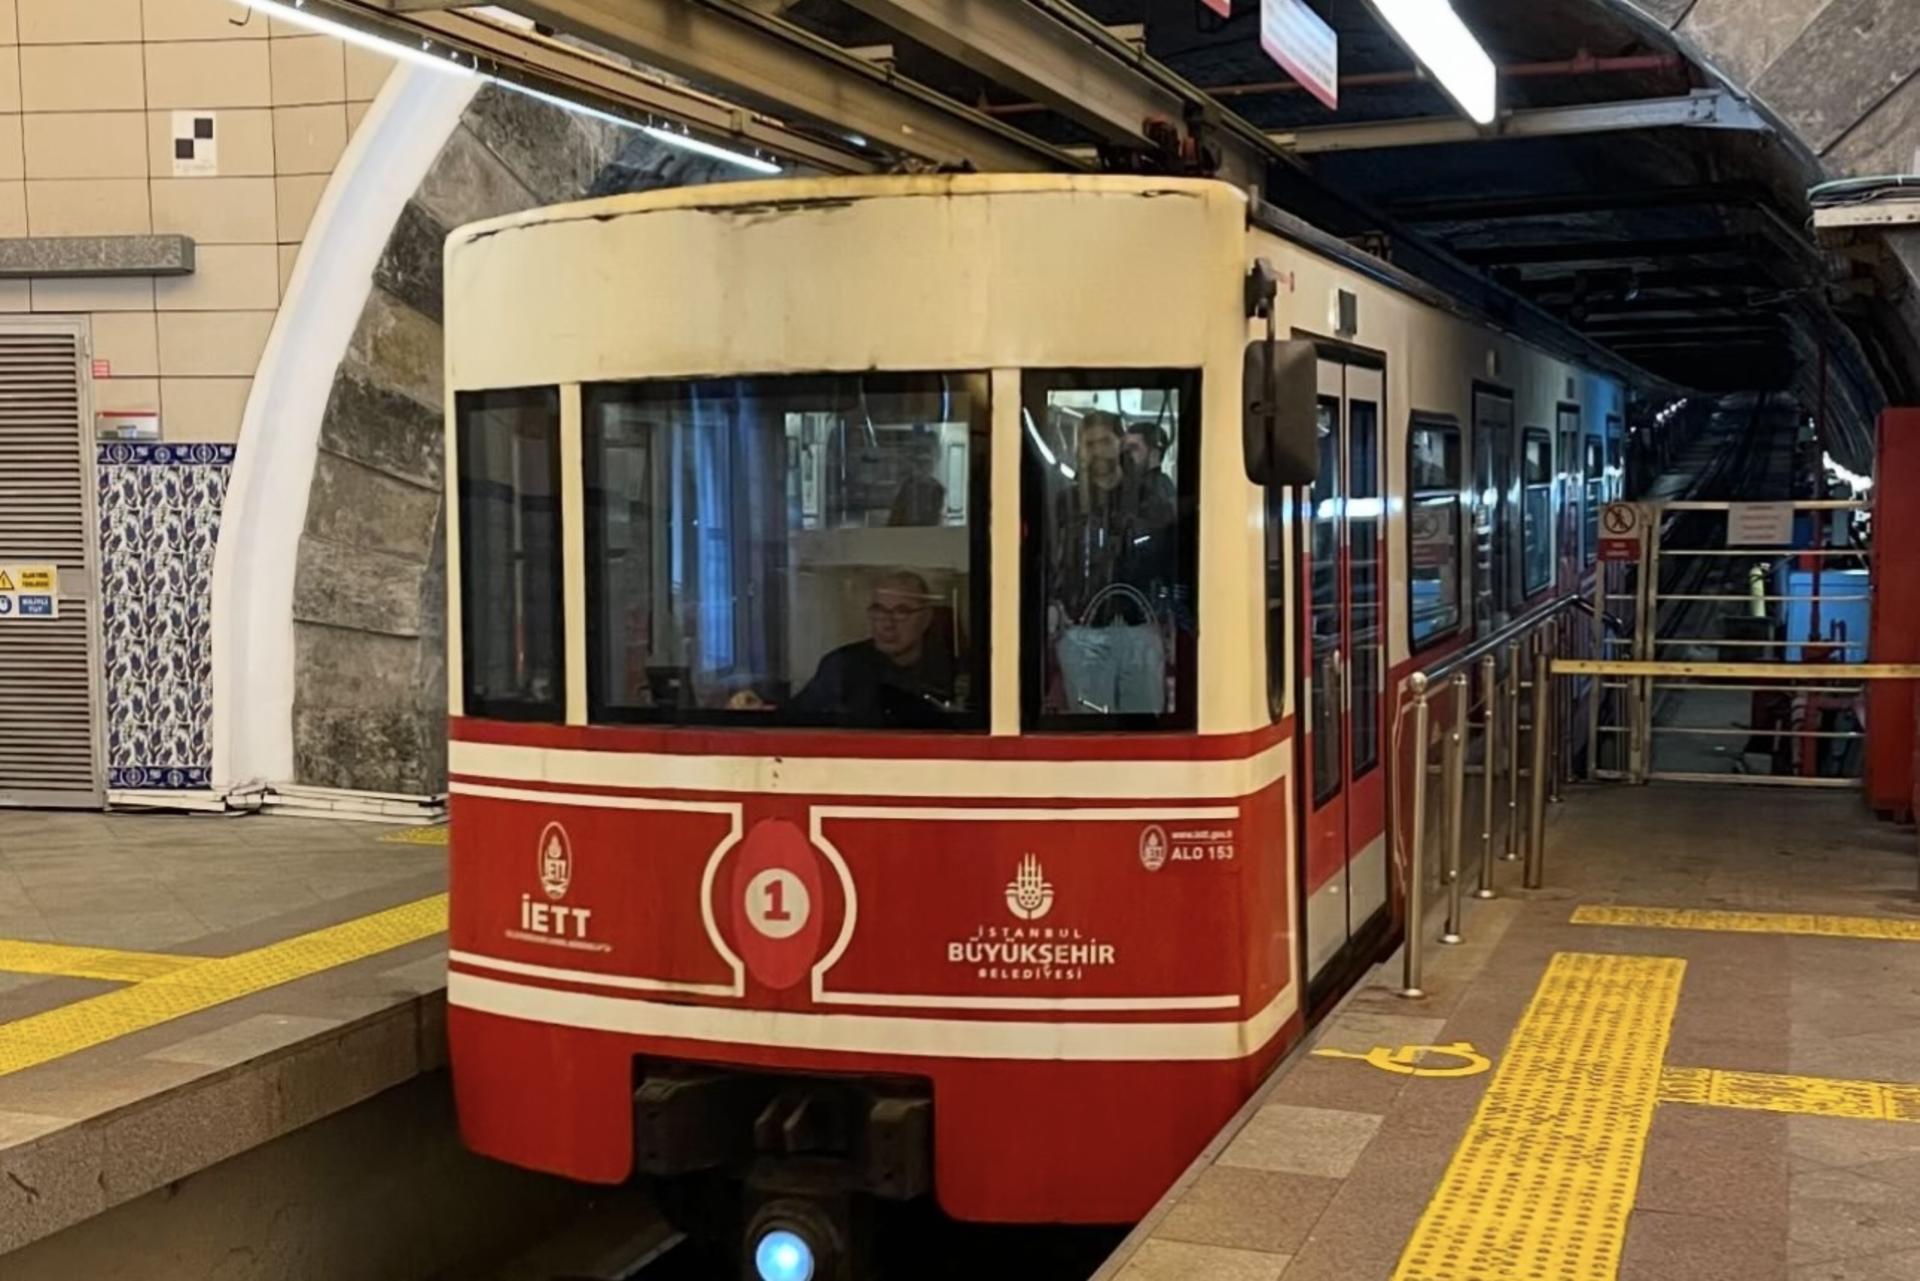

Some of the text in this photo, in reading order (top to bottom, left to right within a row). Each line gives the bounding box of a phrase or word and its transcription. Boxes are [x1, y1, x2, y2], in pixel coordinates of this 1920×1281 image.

[1171, 846, 1204, 860] ALO
[1208, 845, 1235, 860] 153
[764, 879, 791, 921] 1
[521, 892, 592, 938] İETT
[977, 924, 1083, 939] İSTANBUL
[948, 937, 1116, 970] BÜYÜKŞEHİR
[977, 967, 1083, 980] BELEDİYESİ
